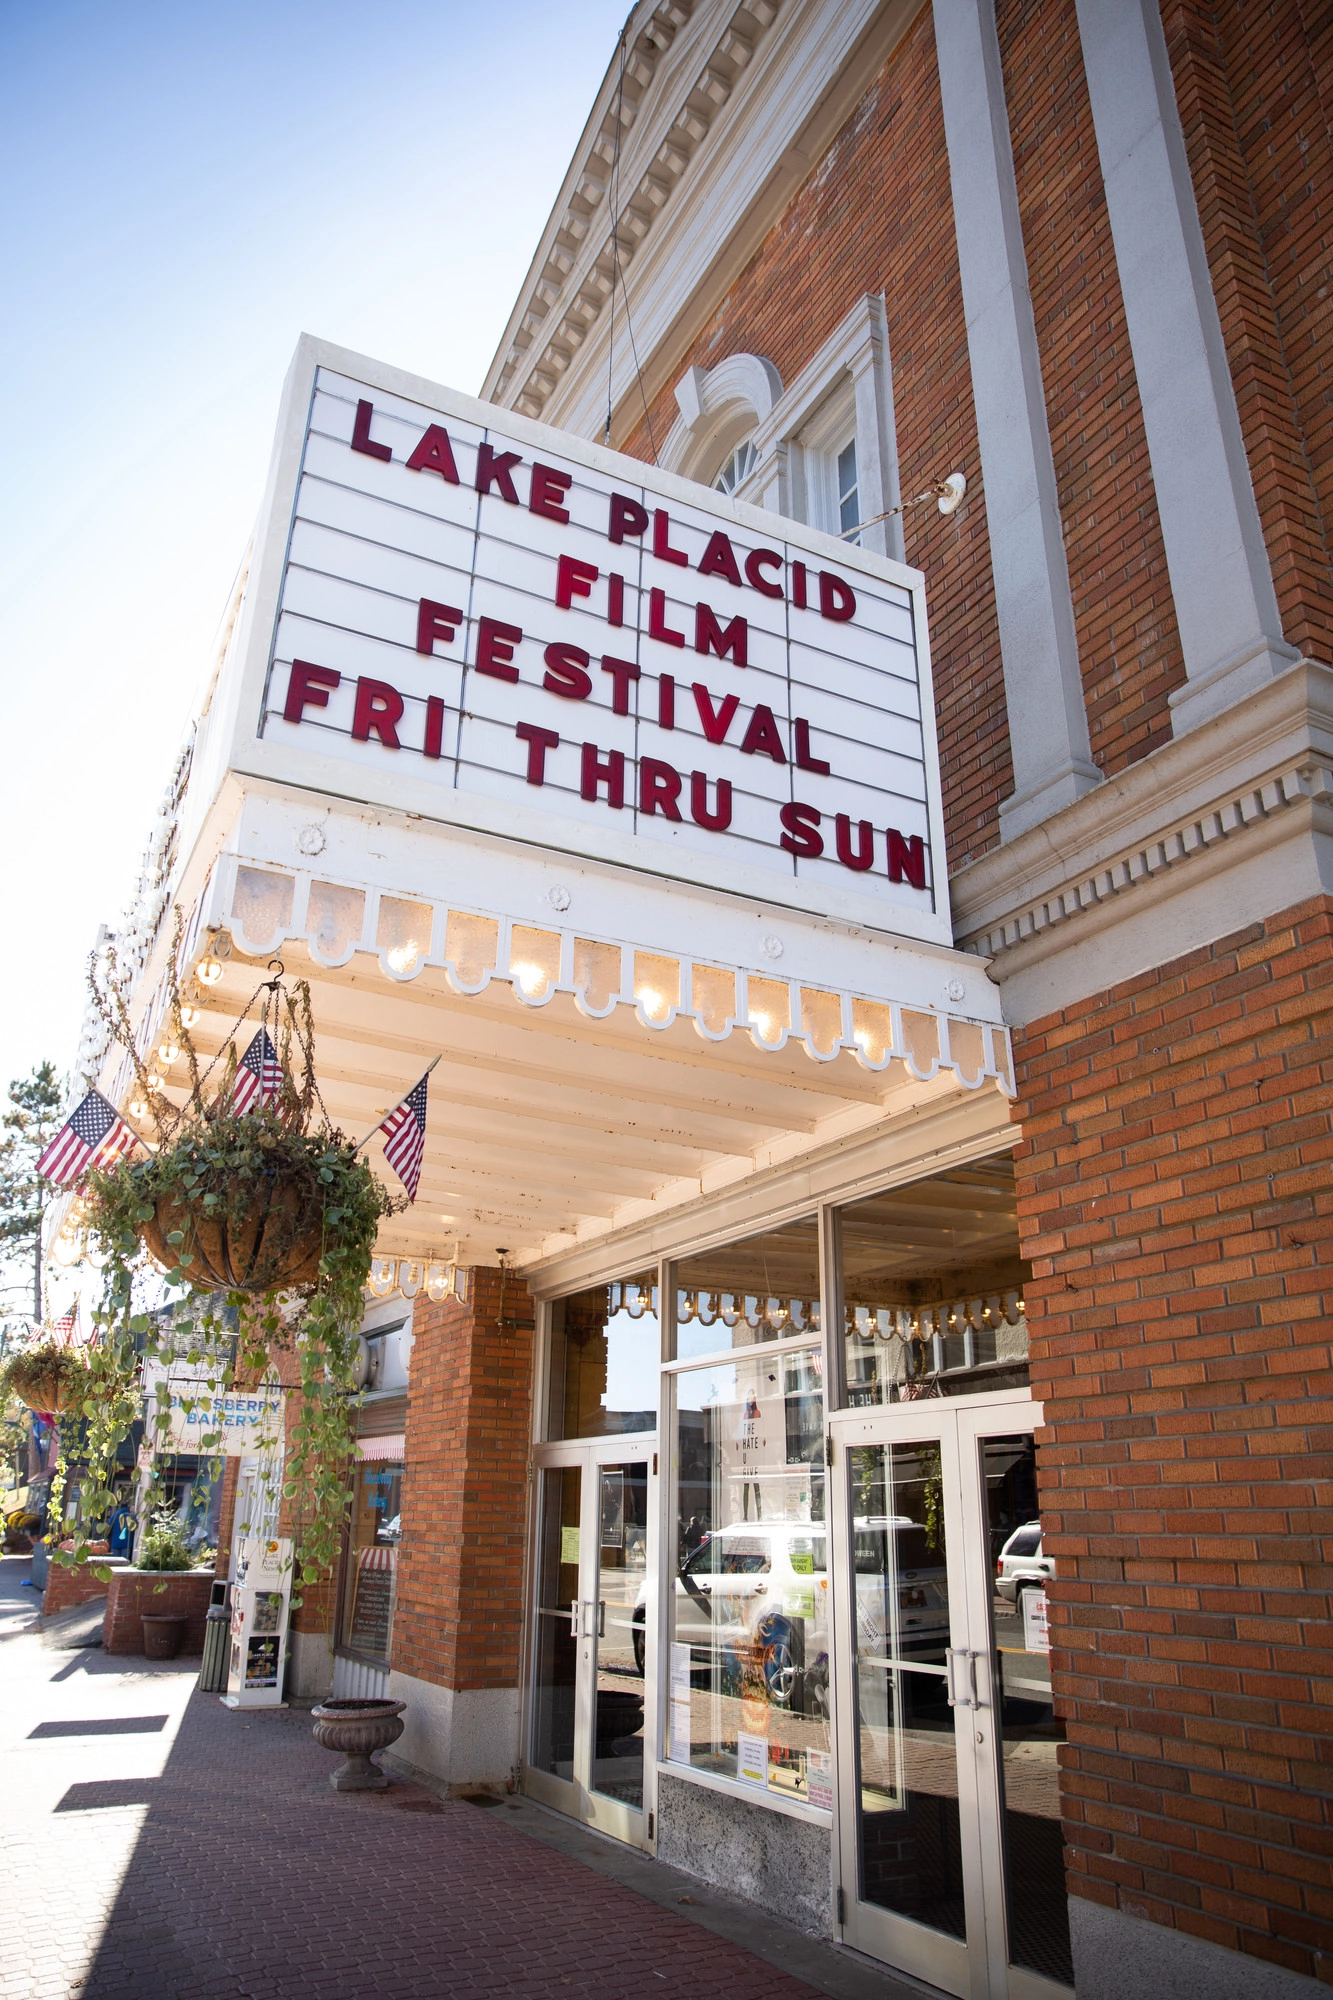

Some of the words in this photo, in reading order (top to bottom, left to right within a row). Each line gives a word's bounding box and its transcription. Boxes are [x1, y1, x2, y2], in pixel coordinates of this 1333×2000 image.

[350, 399, 572, 525] LAKE
[608, 491, 858, 623] PLACID
[555, 554, 748, 667] FILM
[416, 597, 830, 776] FESTIVAL
[283, 659, 444, 759] FRI
[515, 720, 733, 832] THRU
[780, 801, 926, 890] SUN
[186, 1412, 259, 1427] BAKERY
[742, 1437, 759, 1450] HATE
[743, 1422, 755, 1435] THE
[742, 1452, 747, 1465] U
